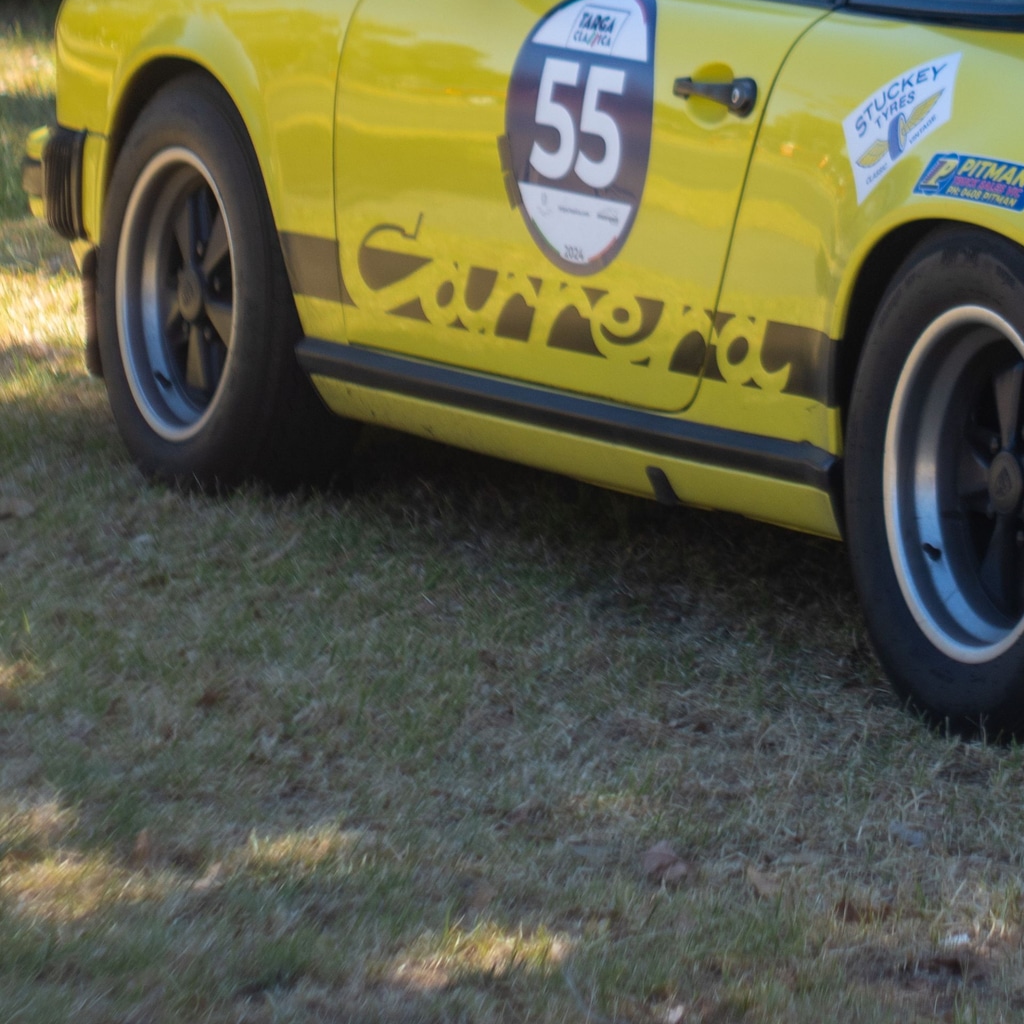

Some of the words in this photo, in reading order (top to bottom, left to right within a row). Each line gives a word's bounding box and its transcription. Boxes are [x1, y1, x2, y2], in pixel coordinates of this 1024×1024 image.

[579, 12, 616, 34] TARGA
[855, 62, 948, 139] STUCKEY
[874, 90, 916, 129] TYRES
[529, 57, 626, 189] 55
[908, 114, 937, 144] VINTAGE
[982, 190, 1018, 208] PITMAN
[564, 244, 585, 262] 2024
[338, 212, 793, 394] Carrera
